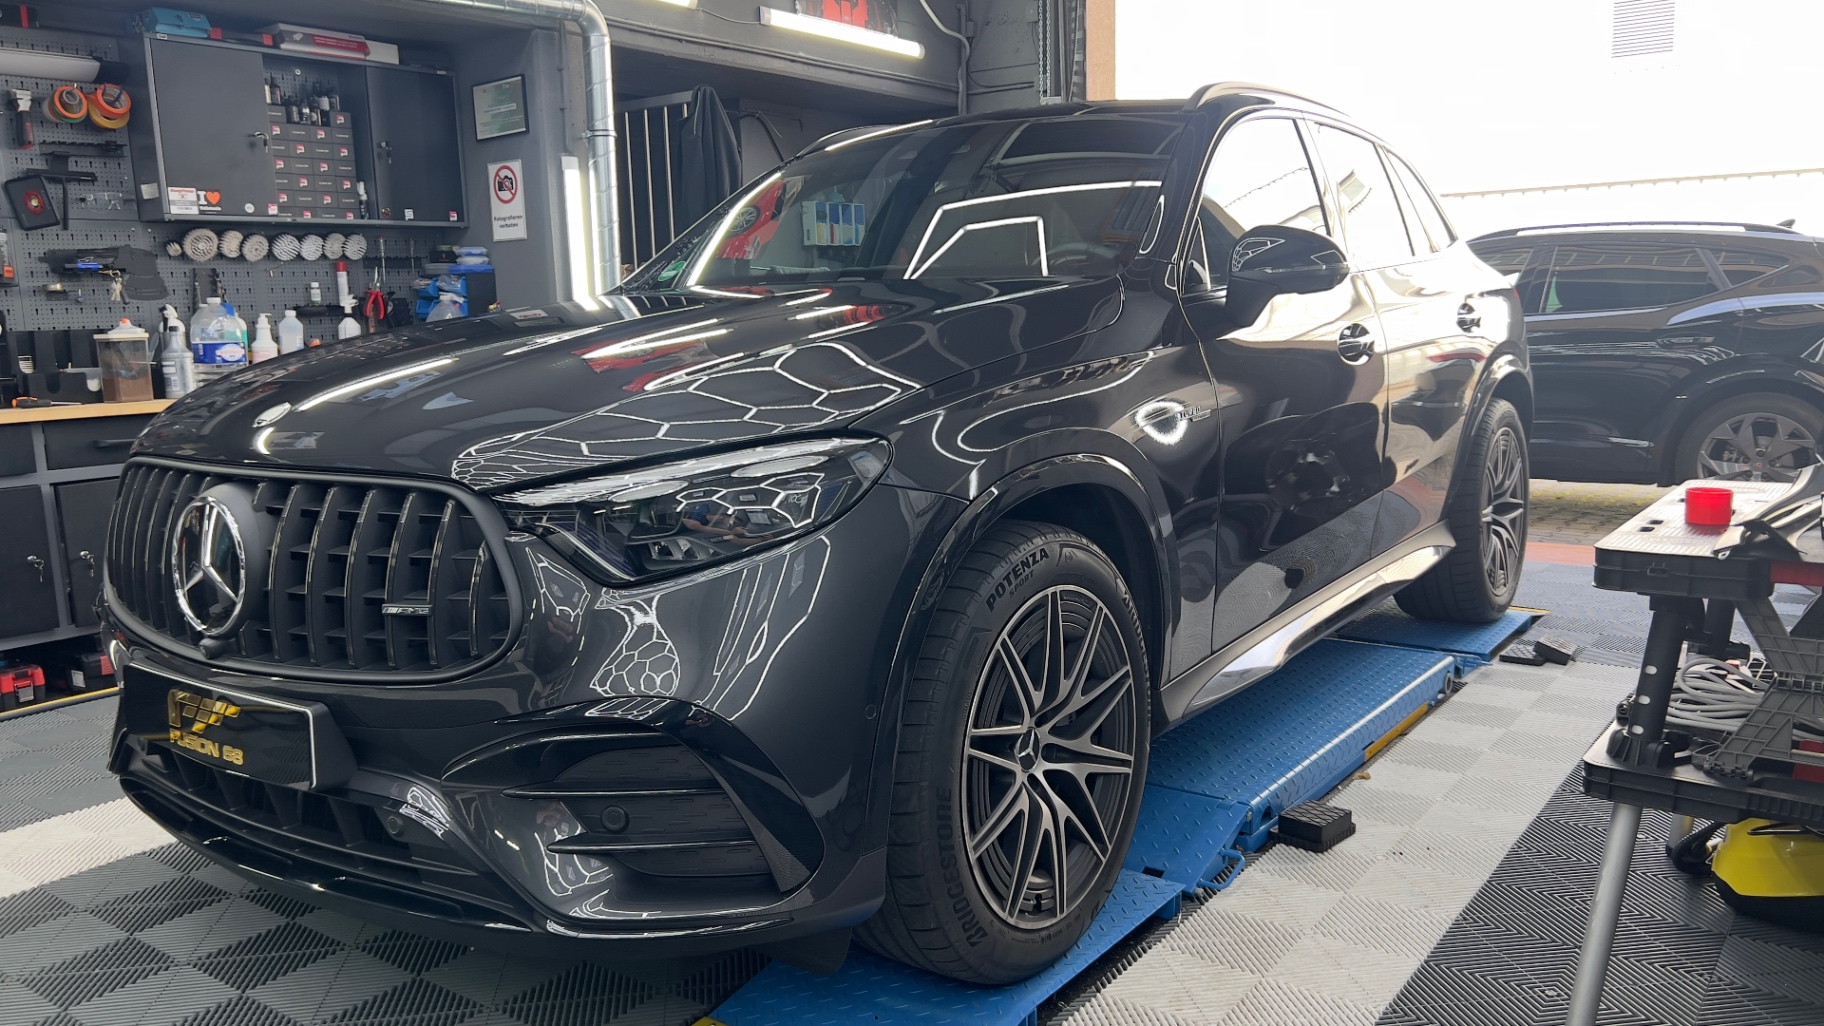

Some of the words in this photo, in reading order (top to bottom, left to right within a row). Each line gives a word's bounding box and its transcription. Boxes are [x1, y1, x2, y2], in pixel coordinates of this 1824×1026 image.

[985, 547, 1050, 612] POTENZA
[1008, 568, 1035, 599] SPORT
[936, 786, 989, 948] BRIDGESTONE
